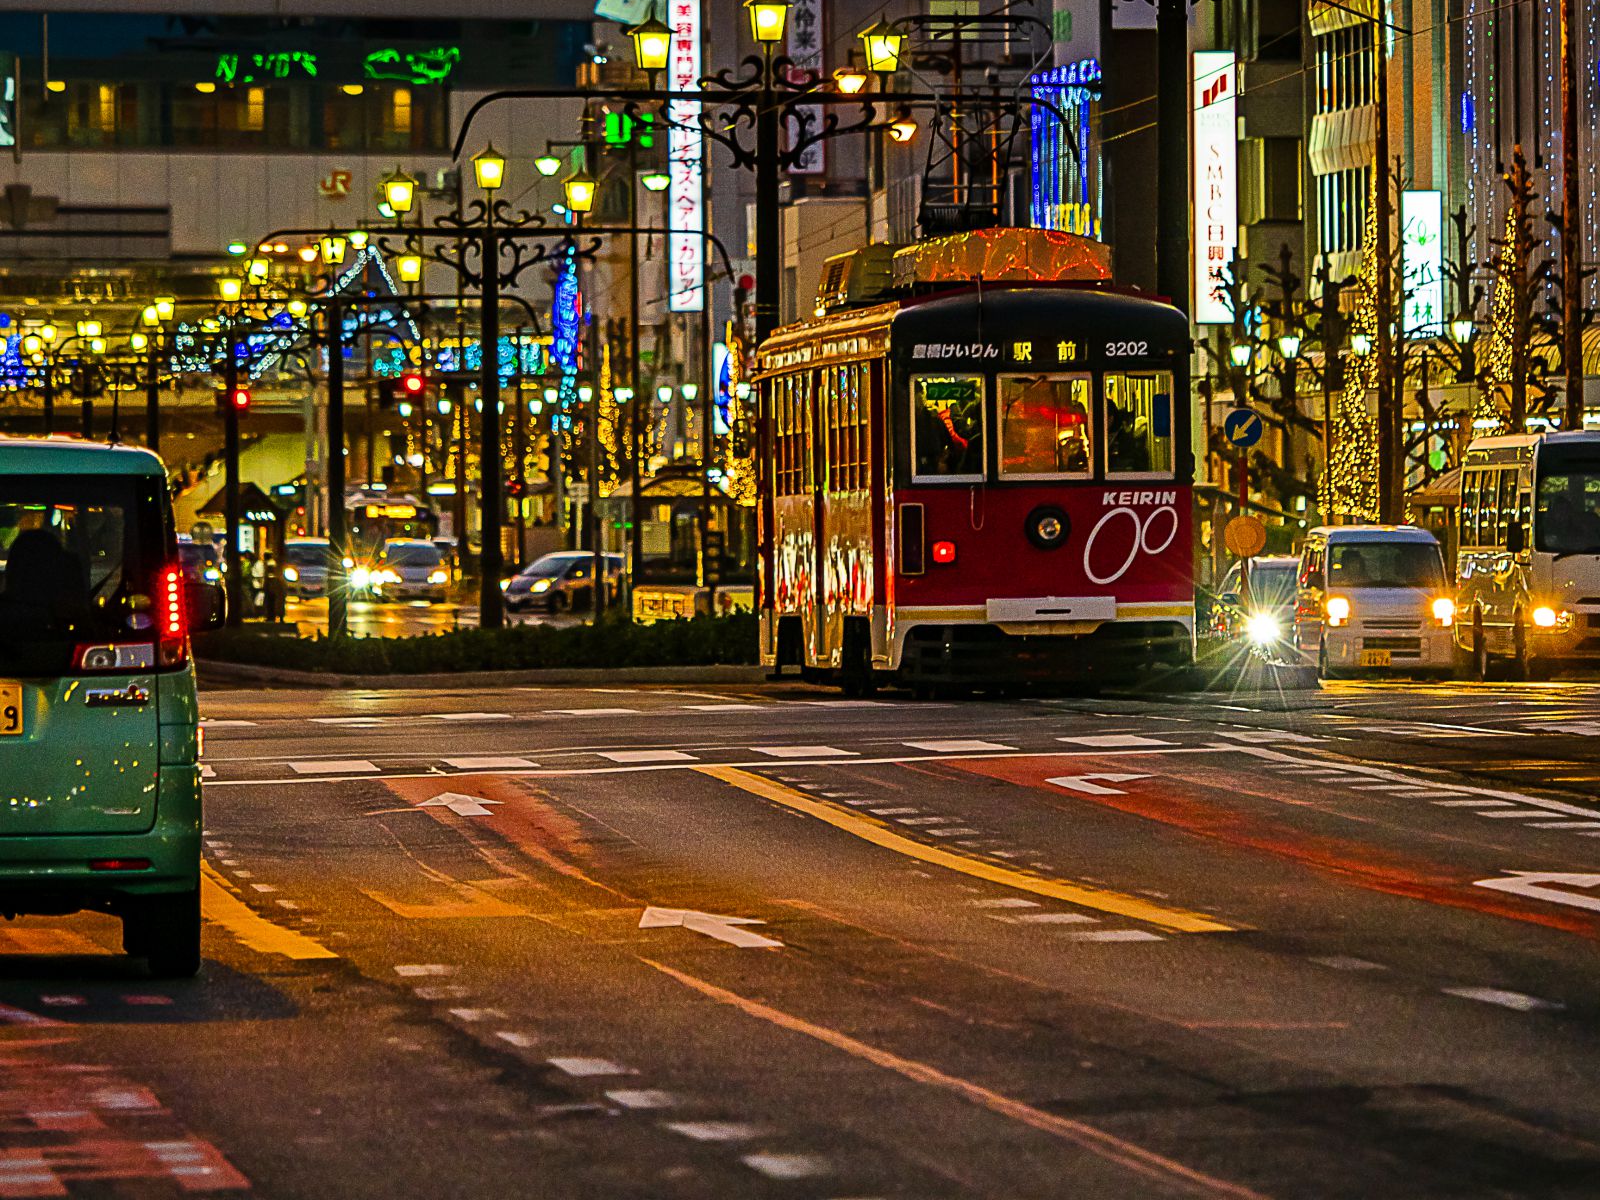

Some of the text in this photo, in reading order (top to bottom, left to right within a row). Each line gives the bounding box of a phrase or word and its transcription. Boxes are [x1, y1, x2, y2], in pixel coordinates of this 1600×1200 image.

[320, 170, 352, 192] JR
[1105, 341, 1148, 356] 3202
[1102, 491, 1177, 506] KEIRIN
